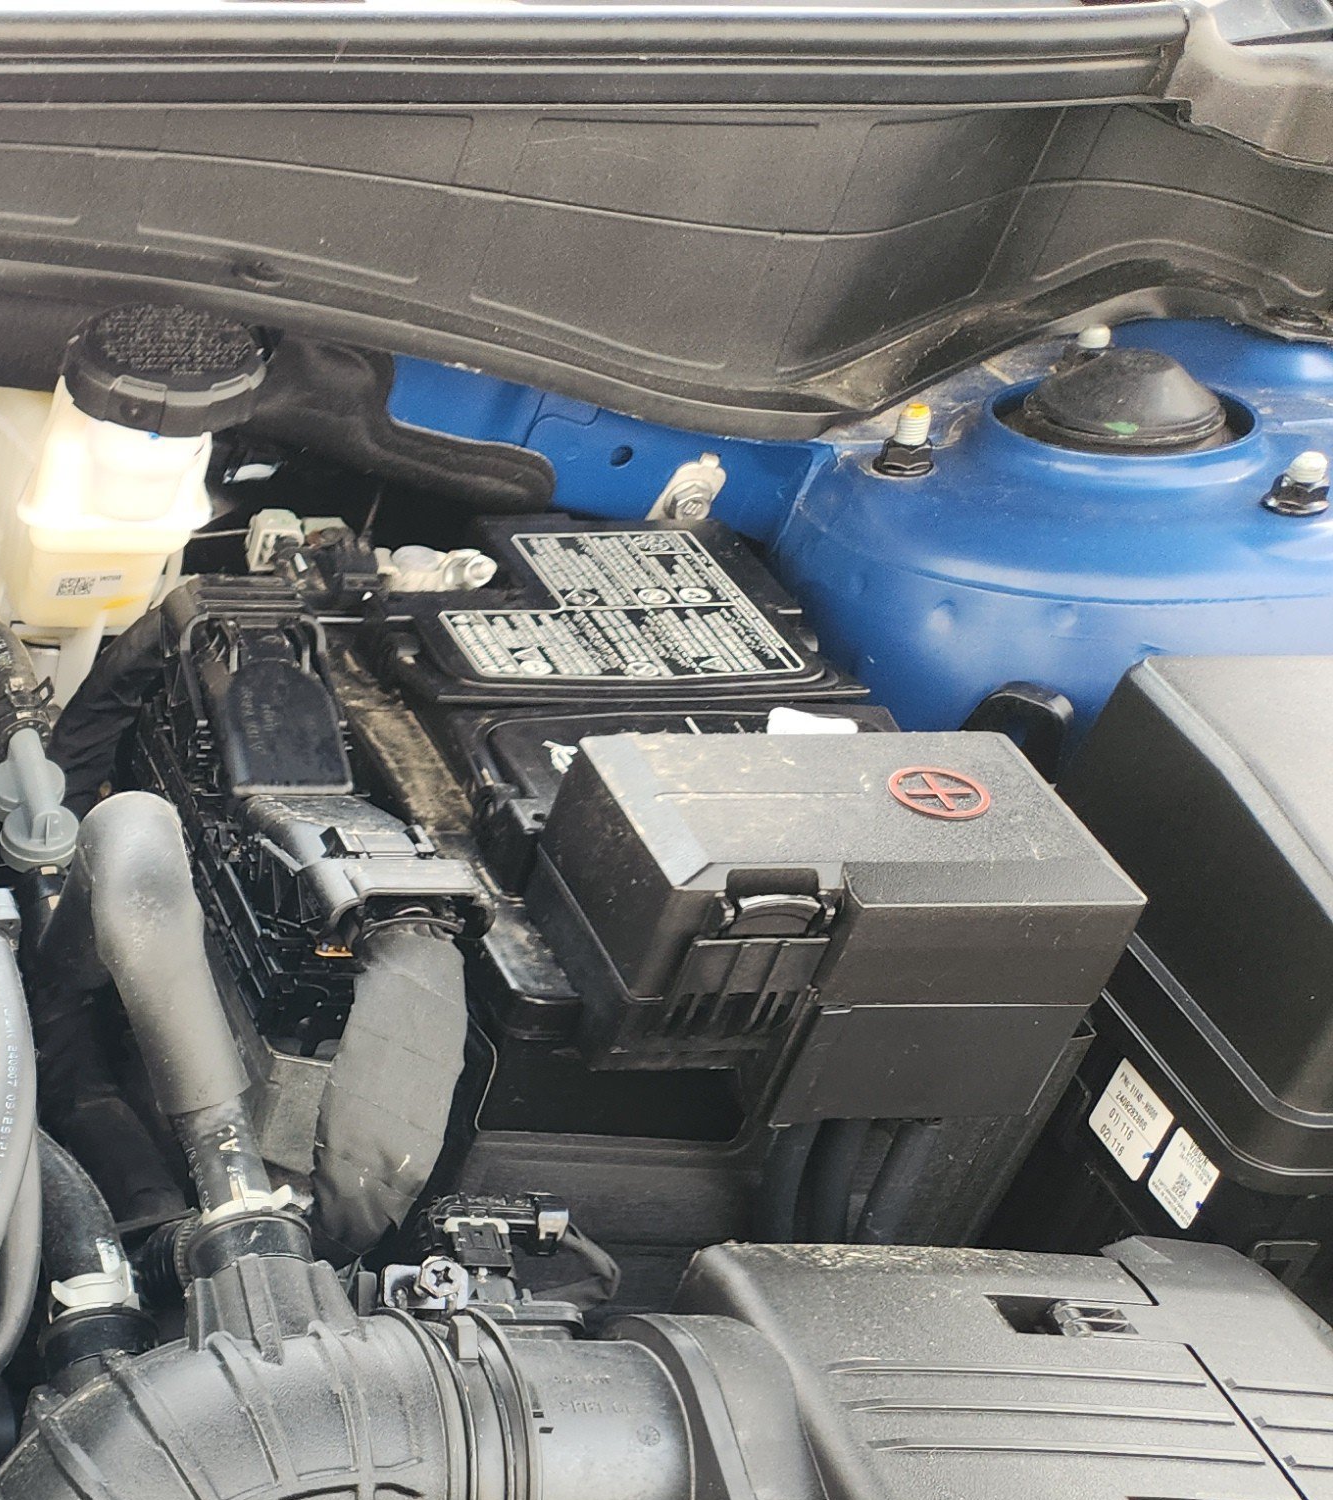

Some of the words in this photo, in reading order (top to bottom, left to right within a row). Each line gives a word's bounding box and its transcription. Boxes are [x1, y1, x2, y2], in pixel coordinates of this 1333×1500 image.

[1109, 1107, 1120, 1126] 01)
[1121, 1121, 1133, 1140] 116
[1100, 1125, 1111, 1143] 02)
[1111, 1138, 1124, 1156] 116
